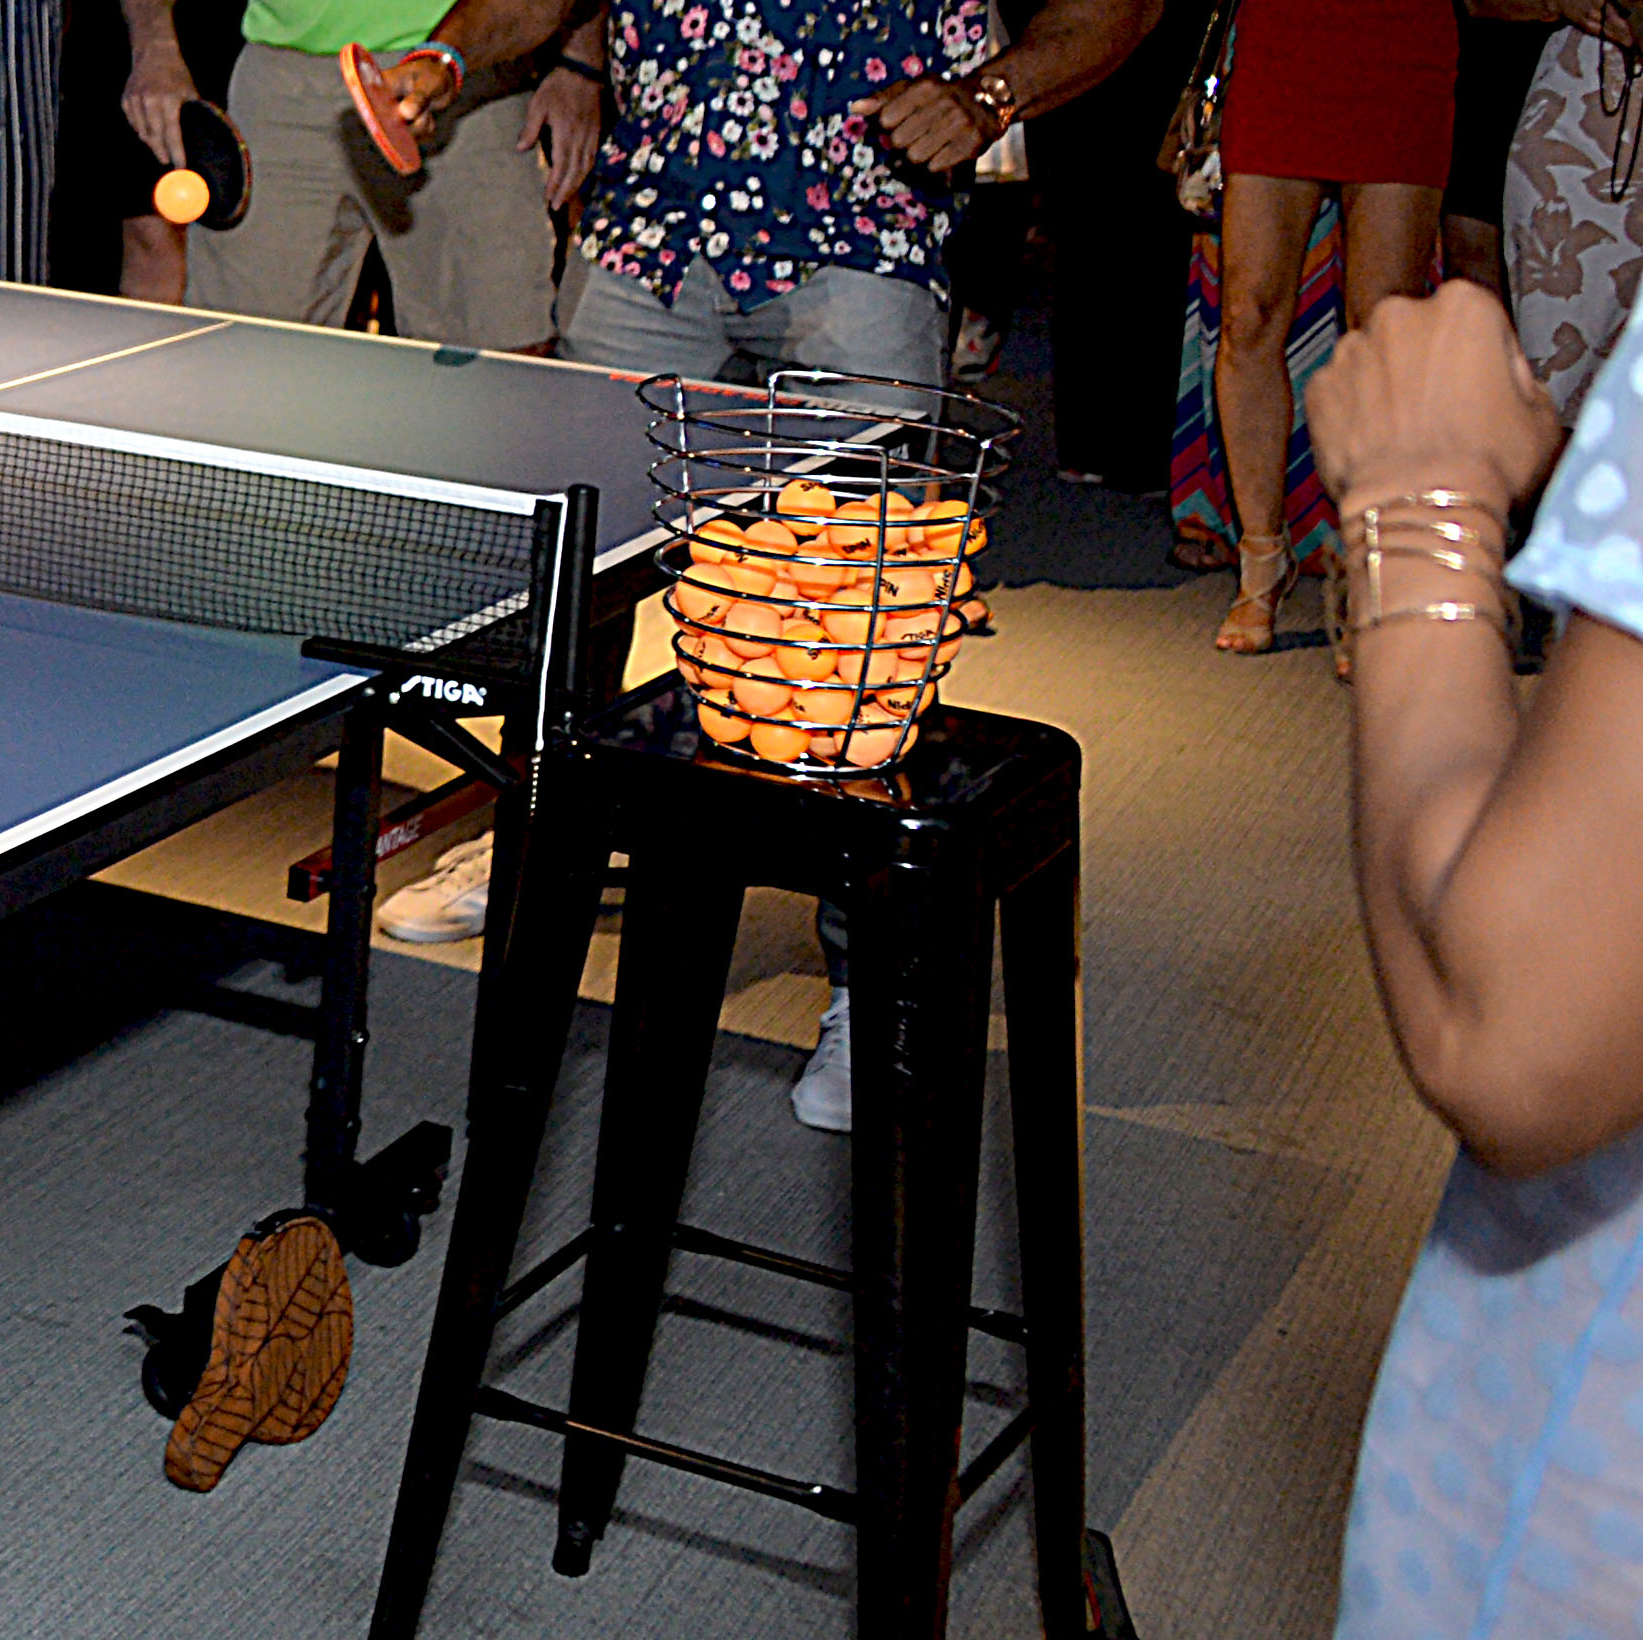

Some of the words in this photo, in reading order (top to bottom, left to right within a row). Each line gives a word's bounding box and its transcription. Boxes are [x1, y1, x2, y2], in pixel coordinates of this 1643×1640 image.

[879, 577, 900, 598] PIN
[401, 674, 485, 706] STIGA
[375, 815, 424, 857] ANTAGE
